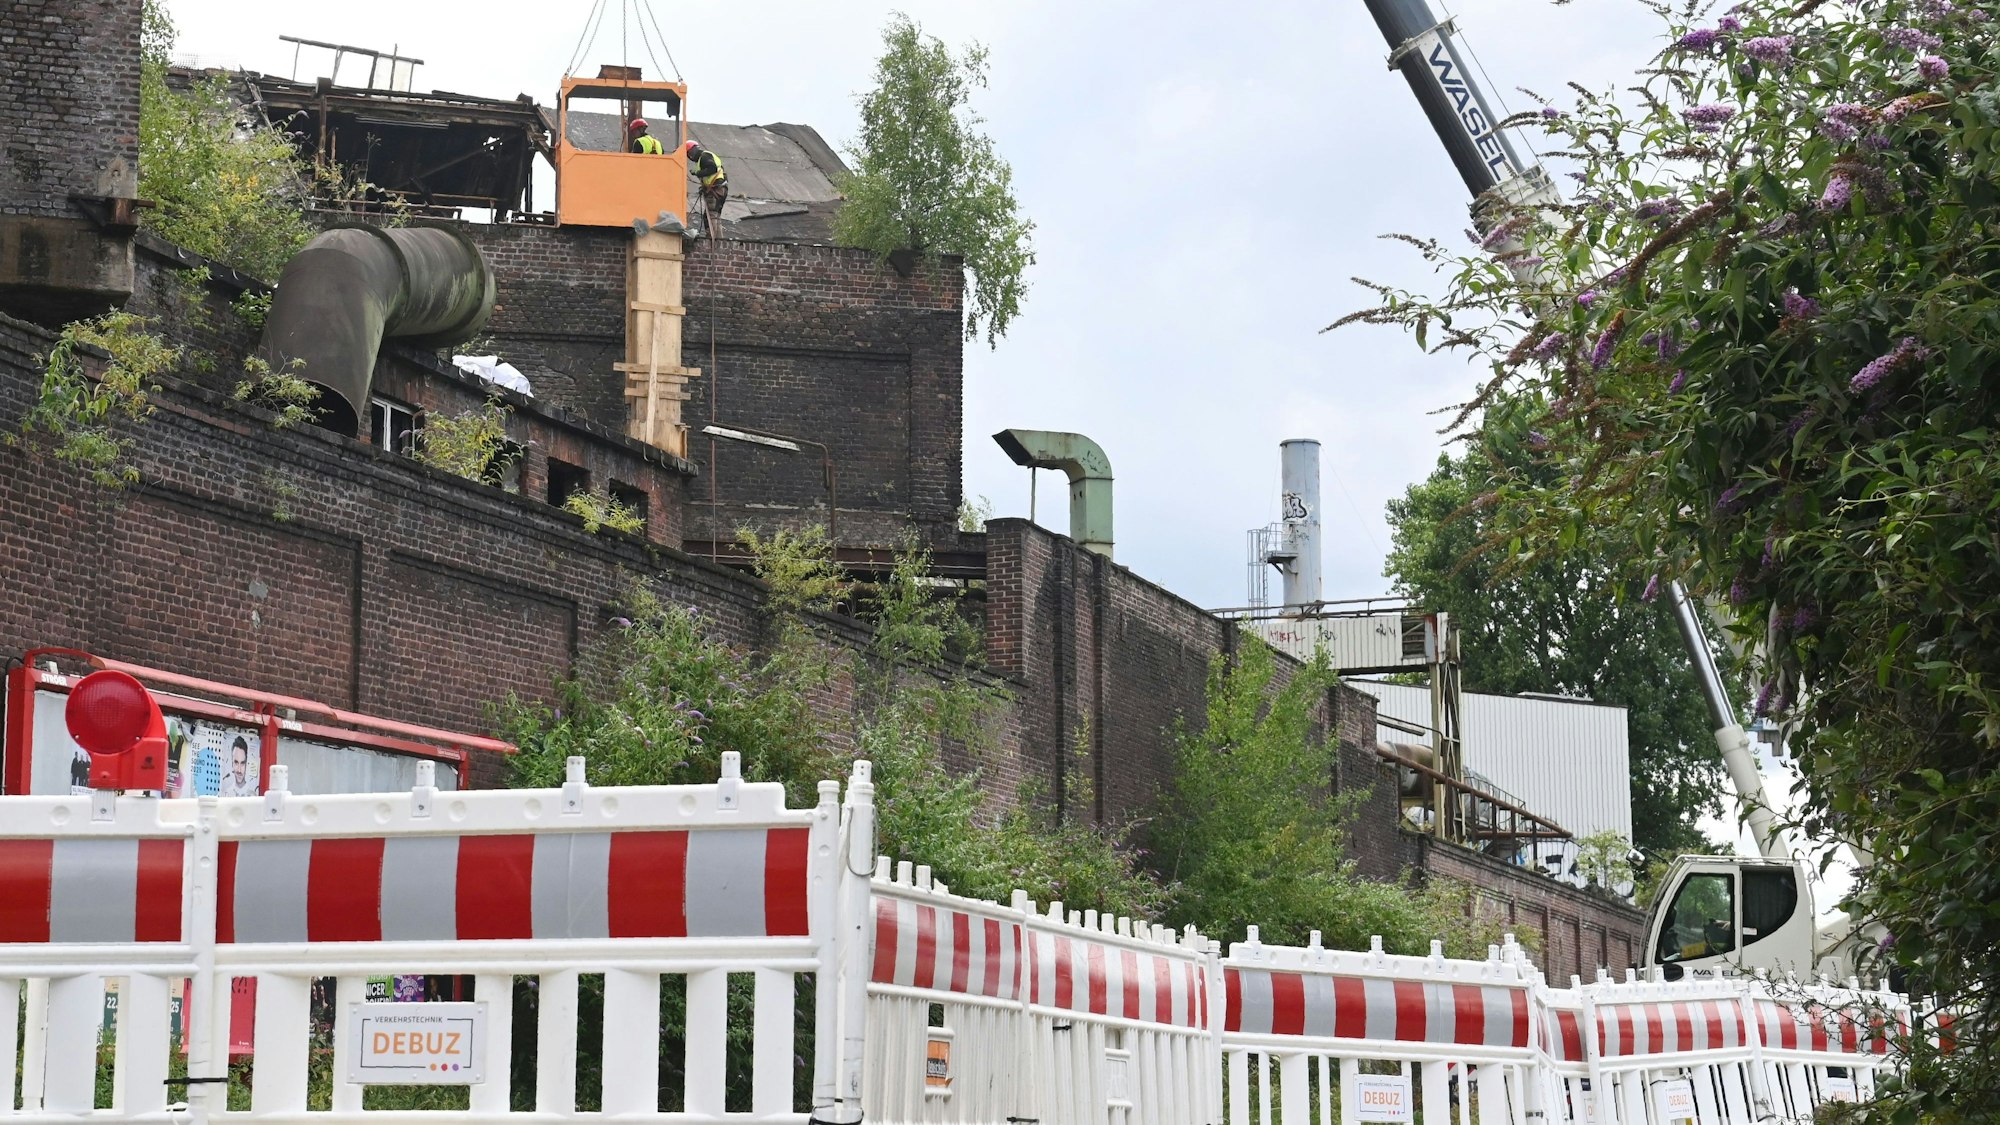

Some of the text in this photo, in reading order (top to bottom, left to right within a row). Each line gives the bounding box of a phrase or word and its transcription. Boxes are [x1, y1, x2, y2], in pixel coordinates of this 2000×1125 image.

[1428, 42, 1506, 182] WASEL
[192, 742, 200, 750] SEE
[192, 750, 200, 758] THE
[1693, 969, 1739, 977] WAEL
[375, 1016, 443, 1024] VERKEHRSTECHNIK
[373, 1032, 461, 1055] DEBUZ
[1364, 1091, 1400, 1106] DEBUZ
